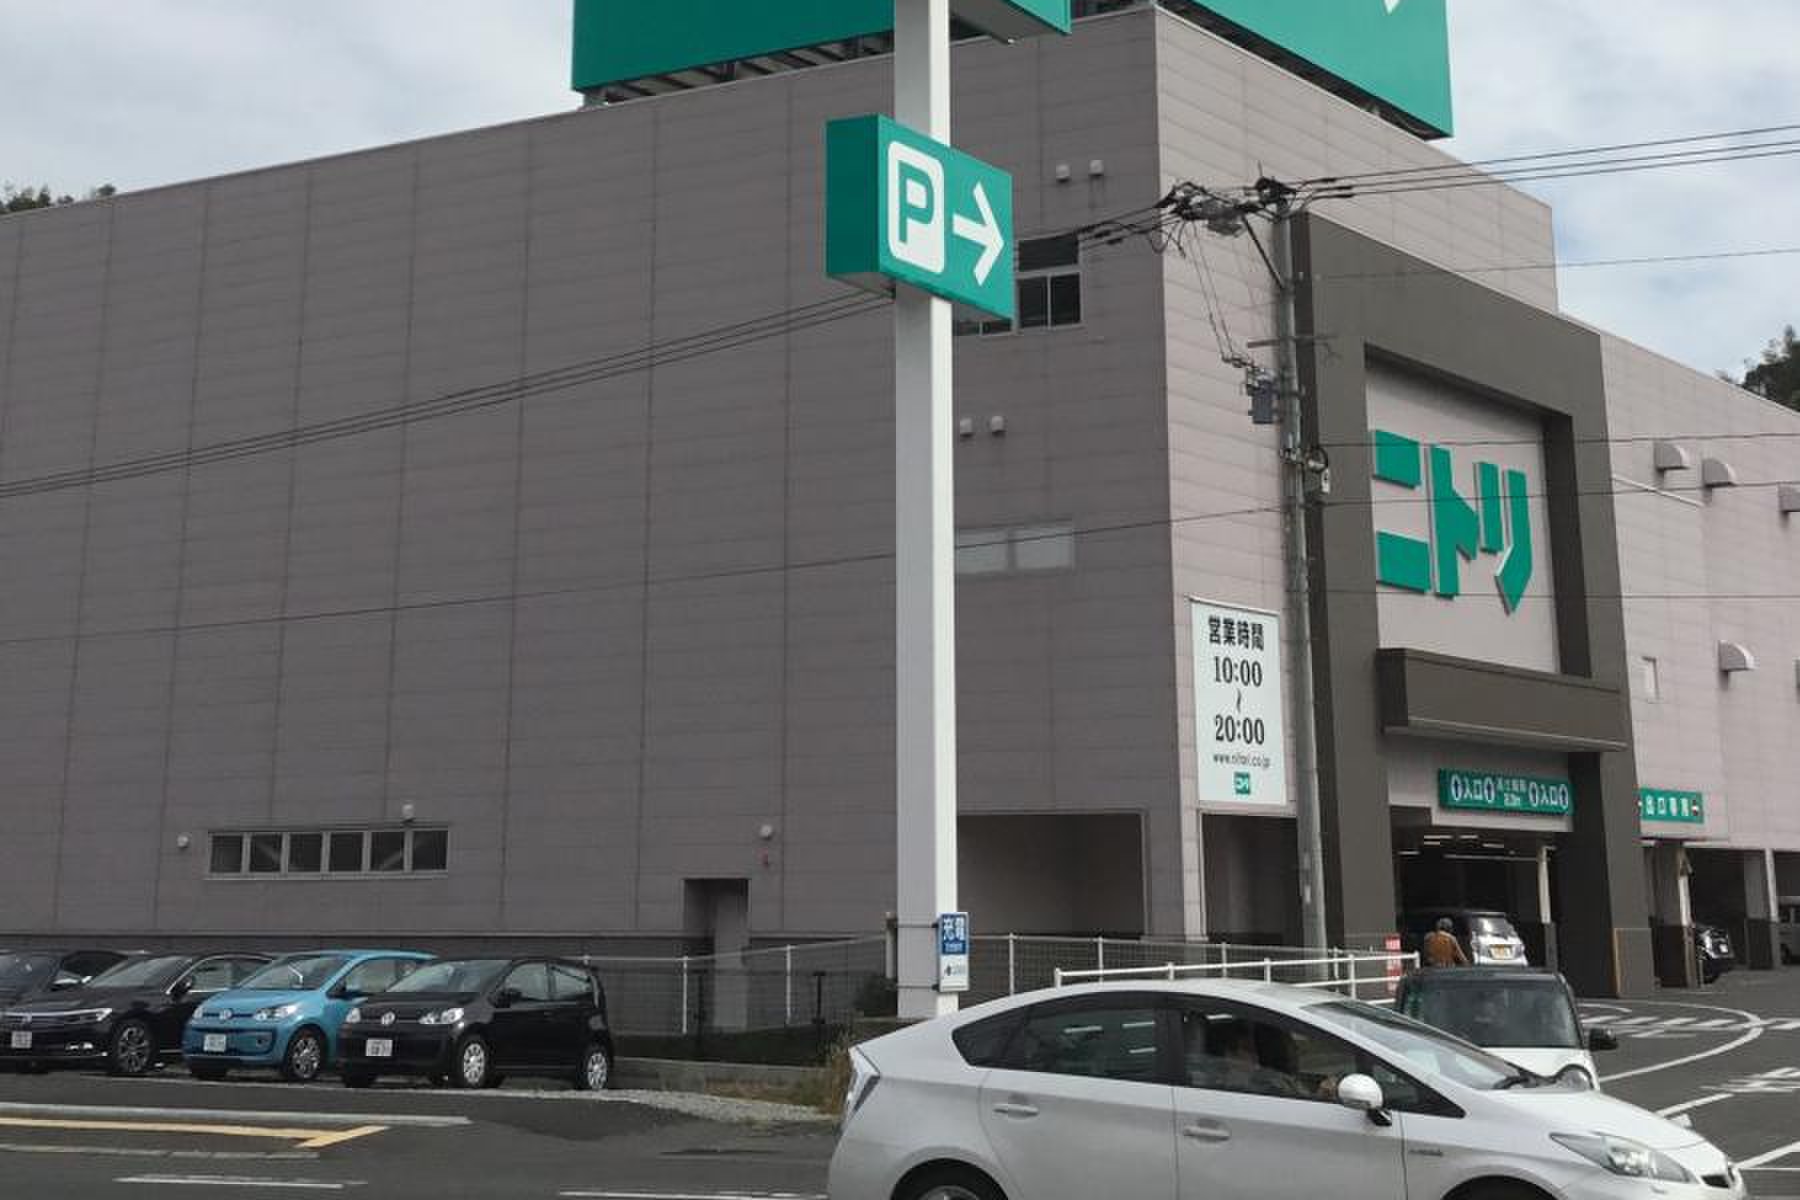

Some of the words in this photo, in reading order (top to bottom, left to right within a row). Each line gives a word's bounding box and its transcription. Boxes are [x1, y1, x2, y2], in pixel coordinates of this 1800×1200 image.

[1373, 429, 1533, 616] ニトリ
[1208, 615, 1265, 651] 営業時間
[1214, 656, 1263, 687] 10:00
[1215, 714, 1265, 745] 20:00
